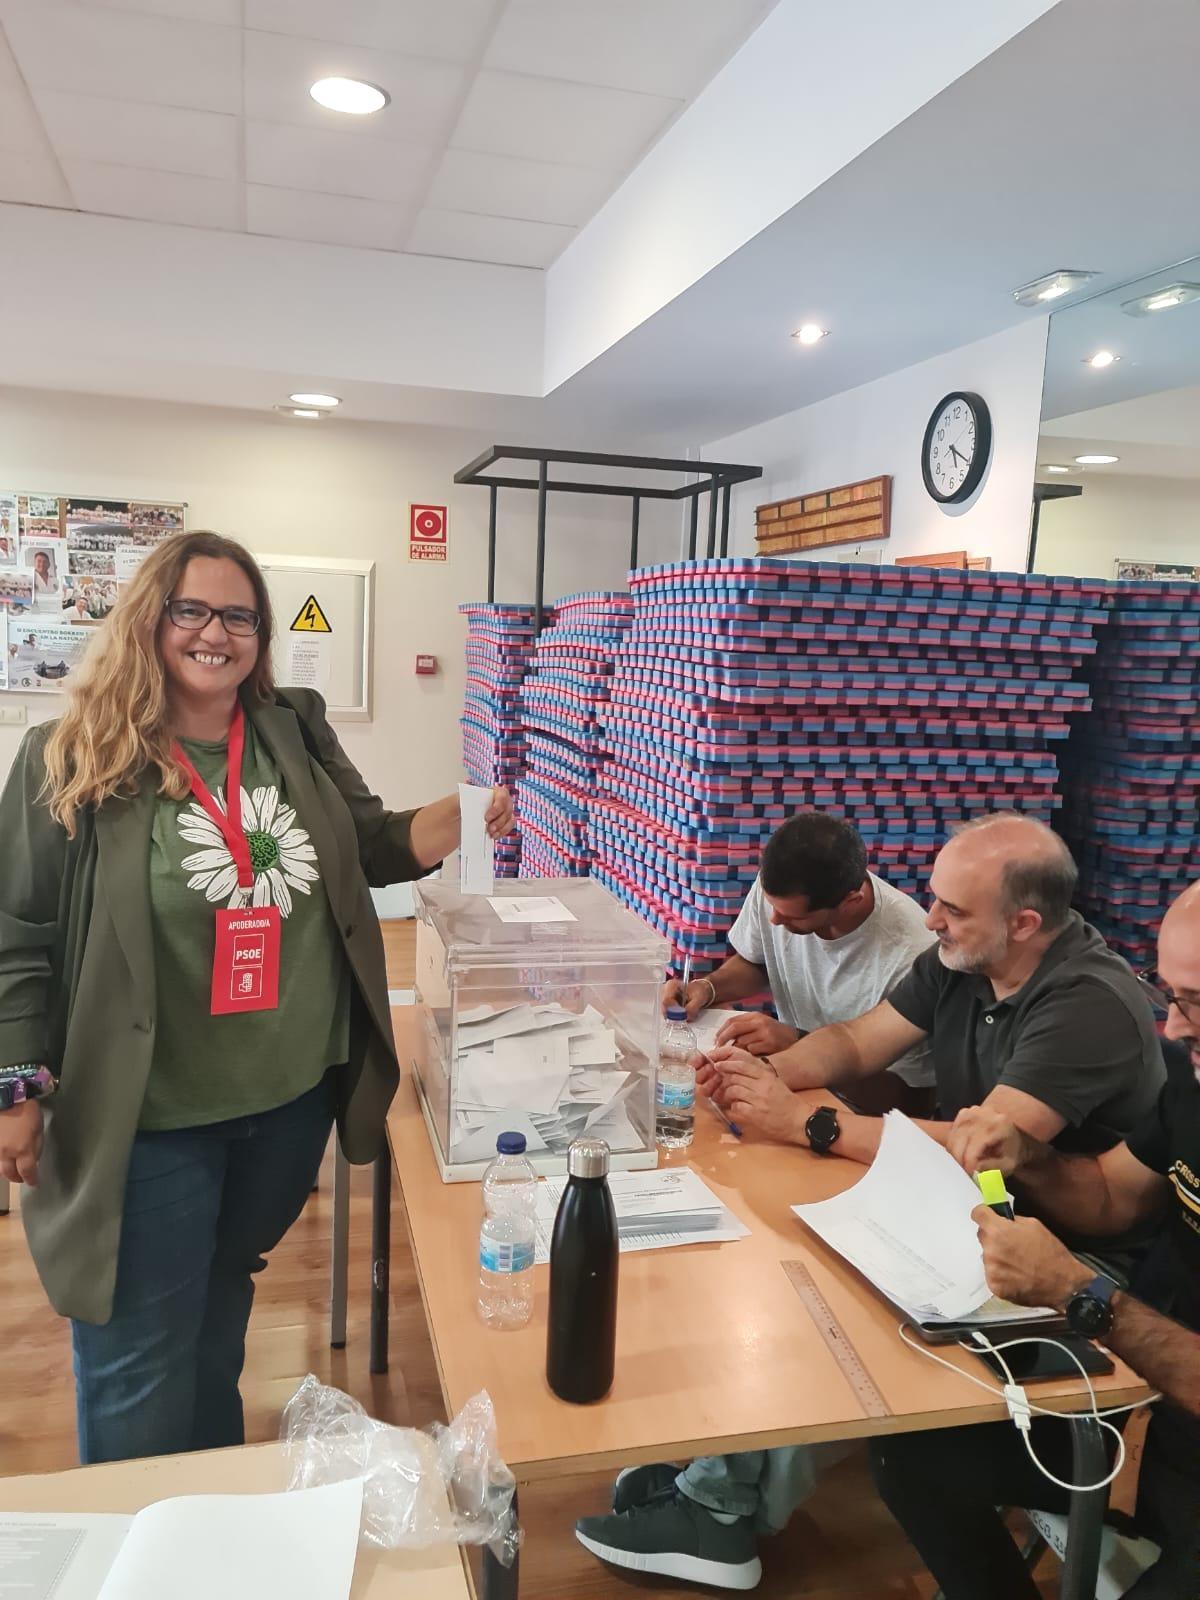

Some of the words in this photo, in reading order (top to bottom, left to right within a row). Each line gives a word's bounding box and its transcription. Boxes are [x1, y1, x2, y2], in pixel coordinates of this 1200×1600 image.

[953, 406, 961, 419] 12
[945, 415, 951, 426] 11
[968, 421, 974, 434] 2
[937, 429, 945, 441] 10
[971, 438, 976, 451] 3
[933, 446, 939, 459] 9
[935, 462, 941, 475] 8
[941, 473, 946, 486] 7
[959, 469, 965, 482] 5
[949, 477, 955, 489] 6
[411, 544, 446, 553] PULSADOR
[411, 551, 420, 559] DE
[421, 552, 446, 560] ALARMA
[236, 949, 261, 960] PSOE
